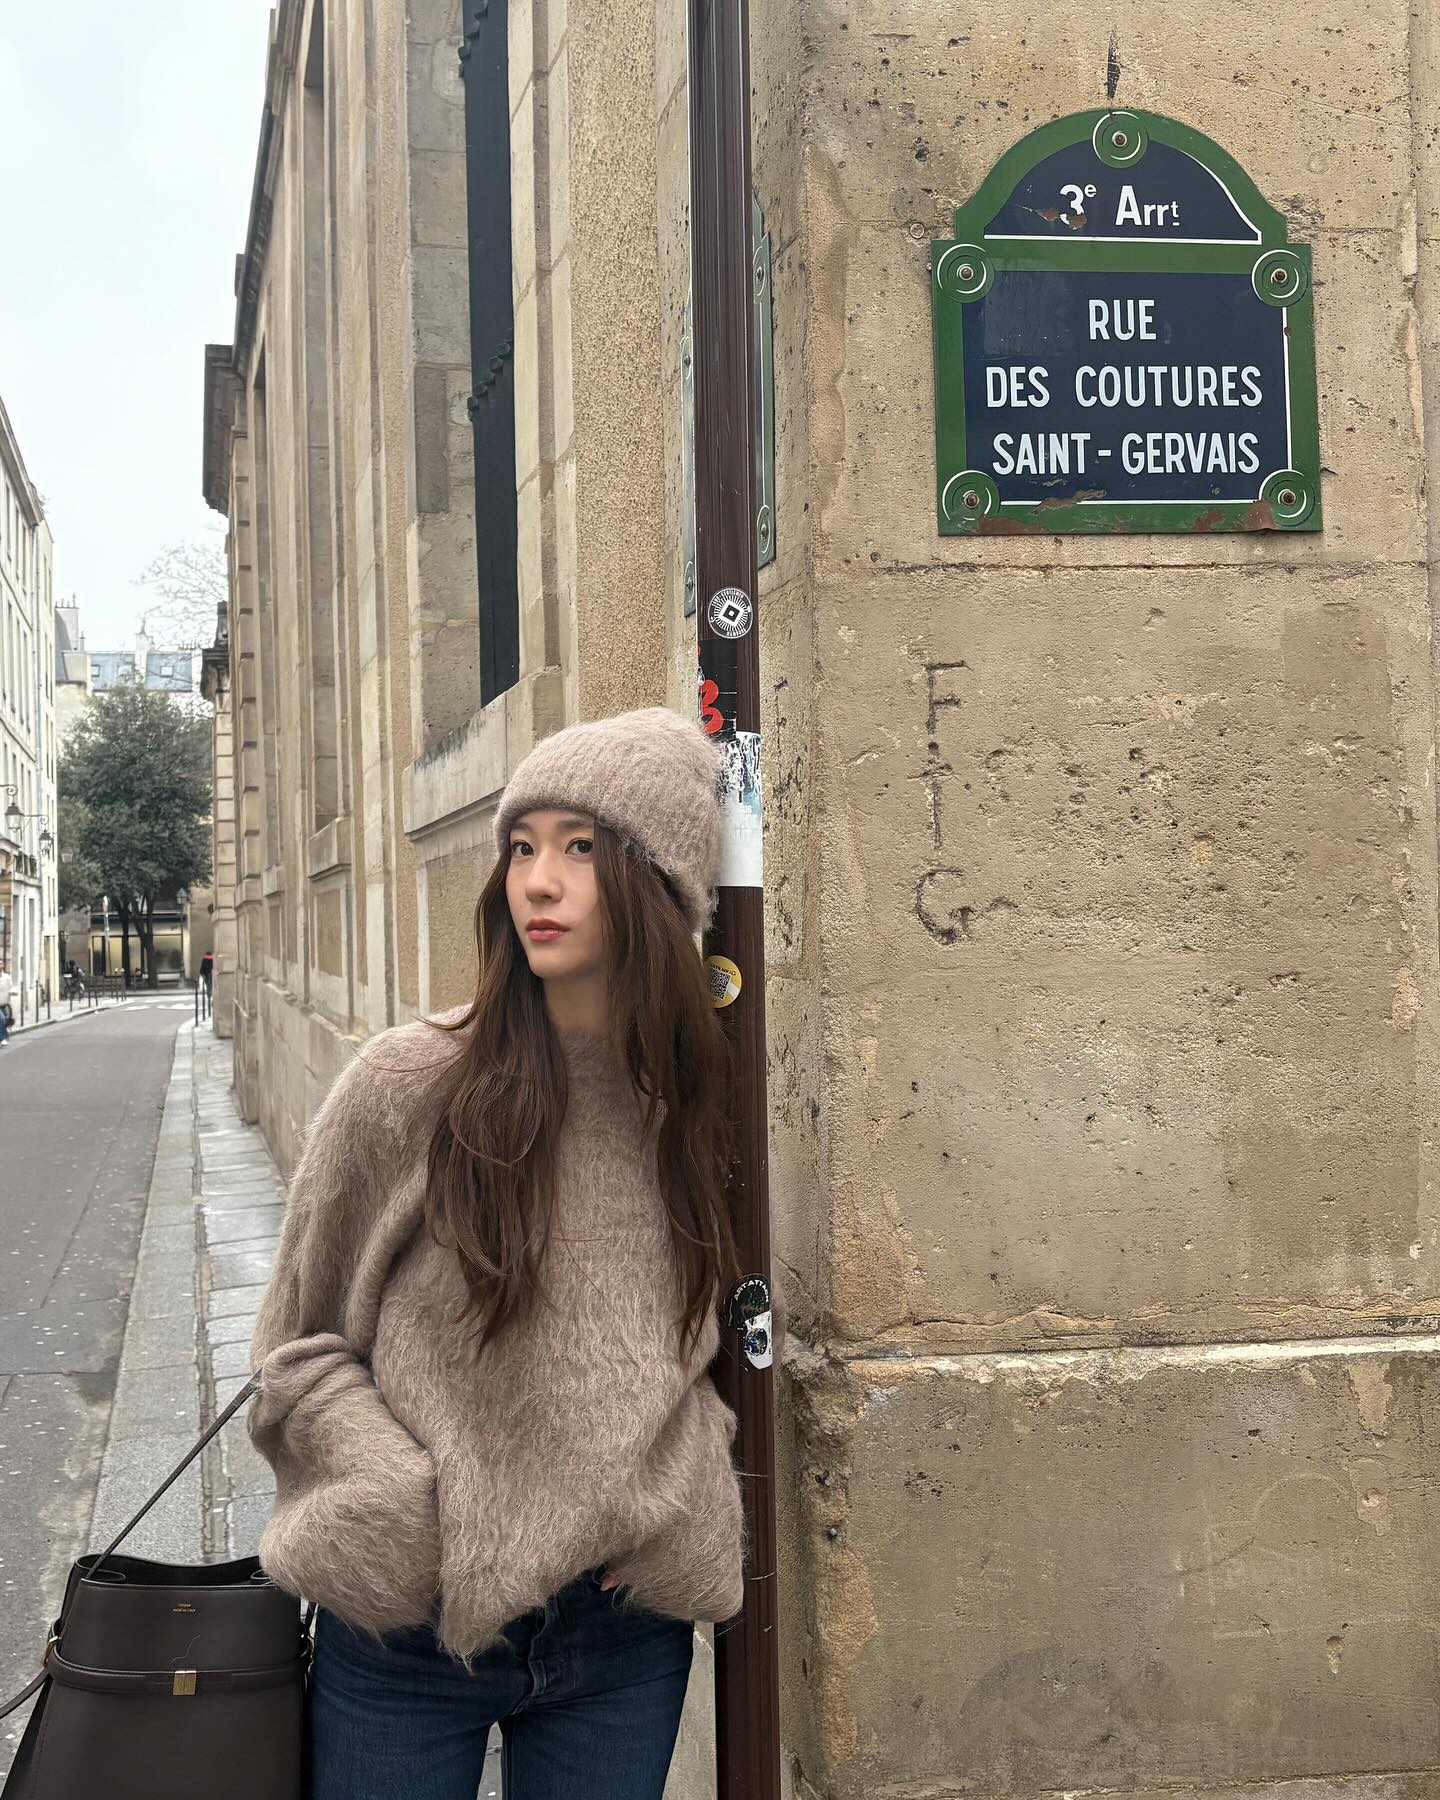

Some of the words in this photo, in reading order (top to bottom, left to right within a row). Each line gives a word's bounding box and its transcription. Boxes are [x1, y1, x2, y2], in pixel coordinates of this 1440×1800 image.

[1115, 185, 1180, 226] Arrt
[1088, 299, 1157, 341] RUE
[985, 365, 1050, 408] DES
[1075, 365, 1263, 408] COUTURES
